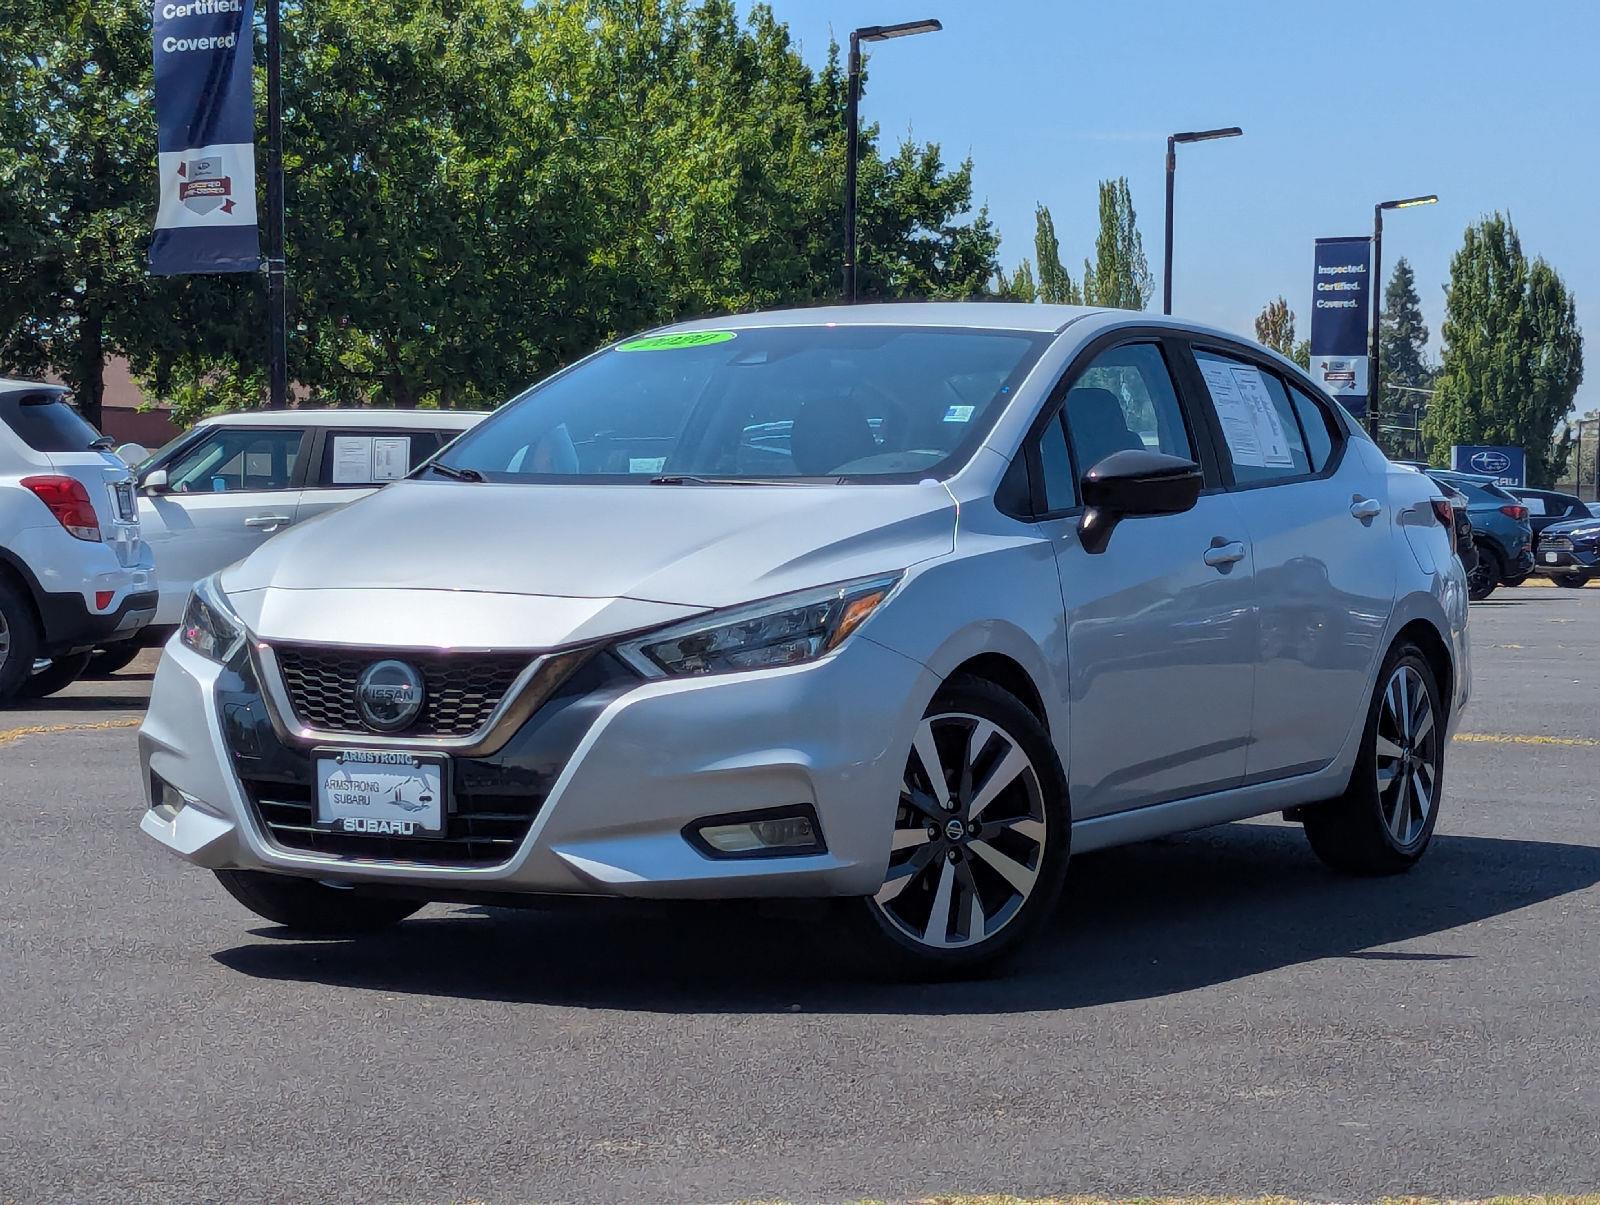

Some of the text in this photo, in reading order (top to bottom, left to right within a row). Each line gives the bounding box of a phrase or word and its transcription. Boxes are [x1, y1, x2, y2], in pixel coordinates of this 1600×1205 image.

[162, 0, 242, 19] Certified.
[1318, 264, 1367, 275] Inspected.
[1317, 281, 1360, 291] Certified.
[1316, 298, 1359, 308] Covered.
[342, 750, 414, 765] ARMSTRONG
[324, 779, 379, 793] ARMSTRONG
[333, 793, 371, 806] SUBARU
[343, 818, 414, 835] SUBARU
